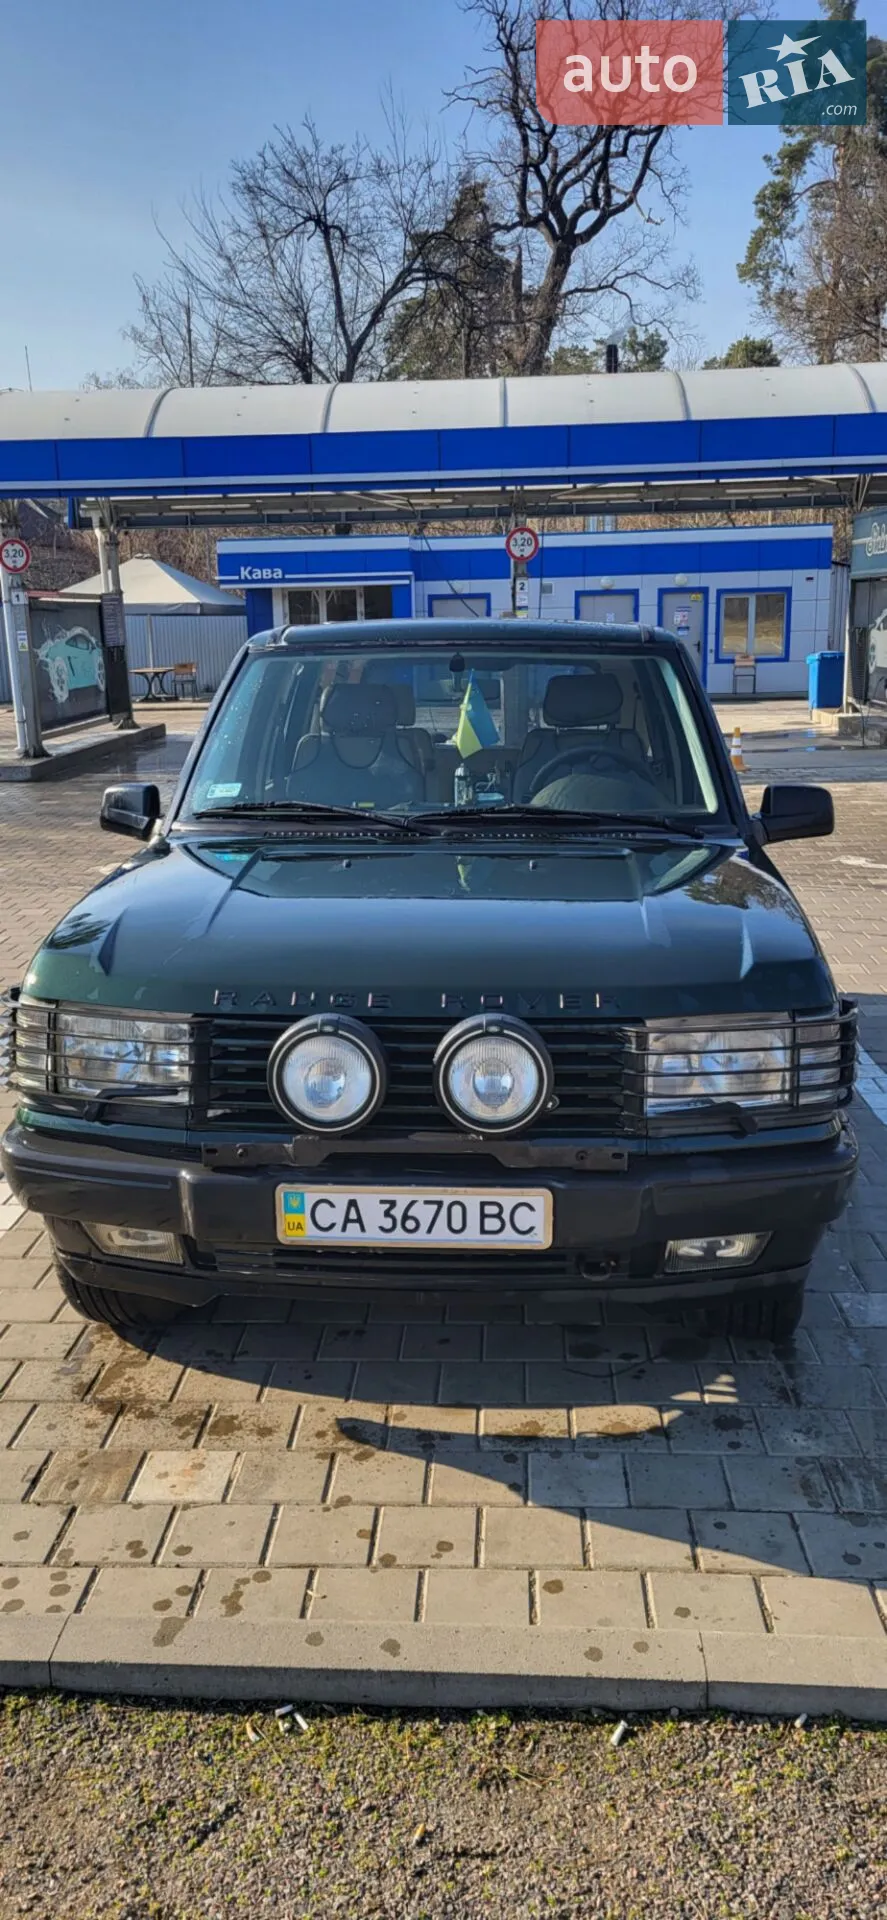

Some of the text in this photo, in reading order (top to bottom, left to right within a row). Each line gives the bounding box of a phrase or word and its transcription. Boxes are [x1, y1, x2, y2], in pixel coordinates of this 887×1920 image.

[240, 566, 282, 579] Кава
[518, 582, 525, 591] 2
[15, 593, 20, 602] 1
[213, 989, 621, 1011] RANGE ROVER
[310, 1199, 537, 1236] CA 3670 BC
[287, 1222, 304, 1233] UA
